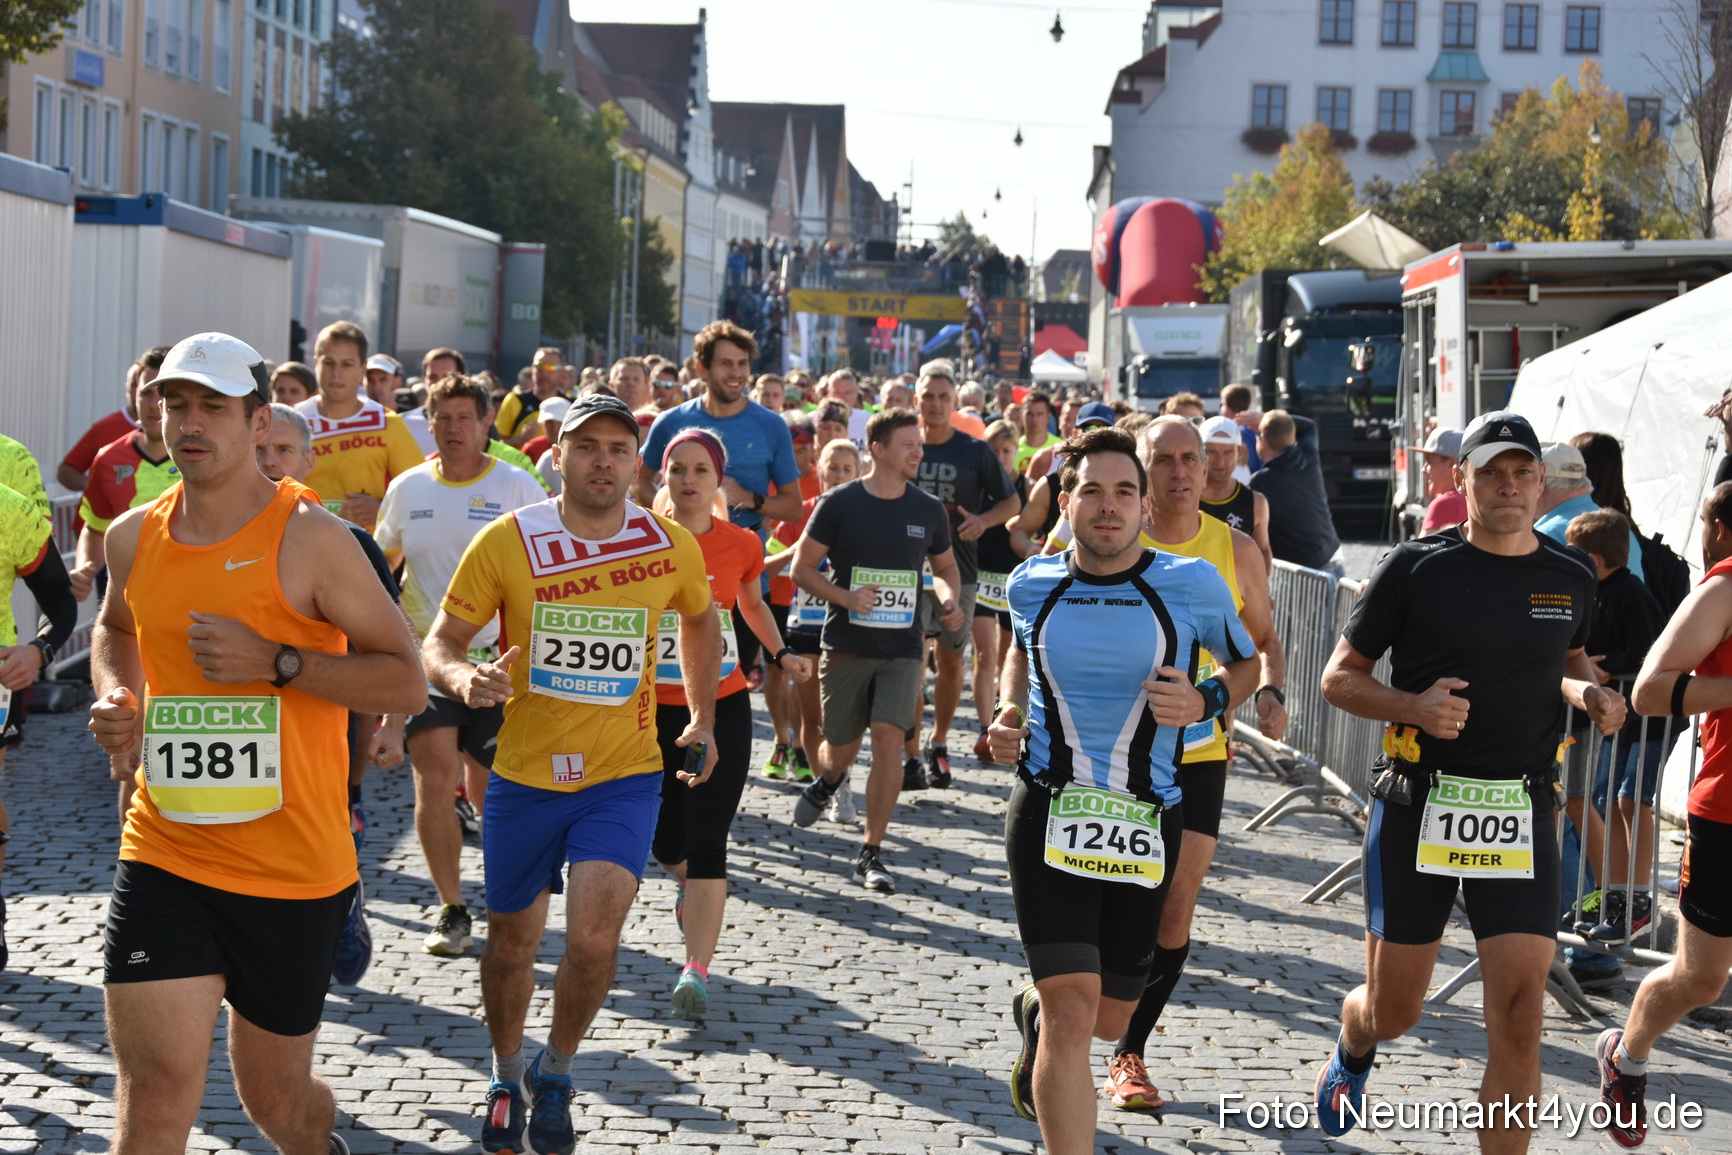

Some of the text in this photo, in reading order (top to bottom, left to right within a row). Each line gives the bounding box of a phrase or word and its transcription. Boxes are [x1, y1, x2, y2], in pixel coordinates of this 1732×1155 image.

[848, 296, 908, 313] START
[312, 435, 387, 457] AX BÖGL
[470, 497, 485, 508] 20
[535, 558, 677, 602] MAX BÖGL
[856, 571, 912, 586] BOCK
[541, 608, 637, 634] BOCK
[543, 638, 633, 672] 2390
[551, 675, 620, 694] ROBERT
[152, 702, 267, 729] BOCK
[157, 742, 258, 779] 1381
[1436, 781, 1525, 807] BOCK
[1060, 792, 1152, 826] BOCK
[1062, 823, 1151, 856] 1246
[1438, 812, 1519, 844] 1009
[1064, 855, 1144, 874] MICHAEL
[1448, 852, 1503, 866] PETER
